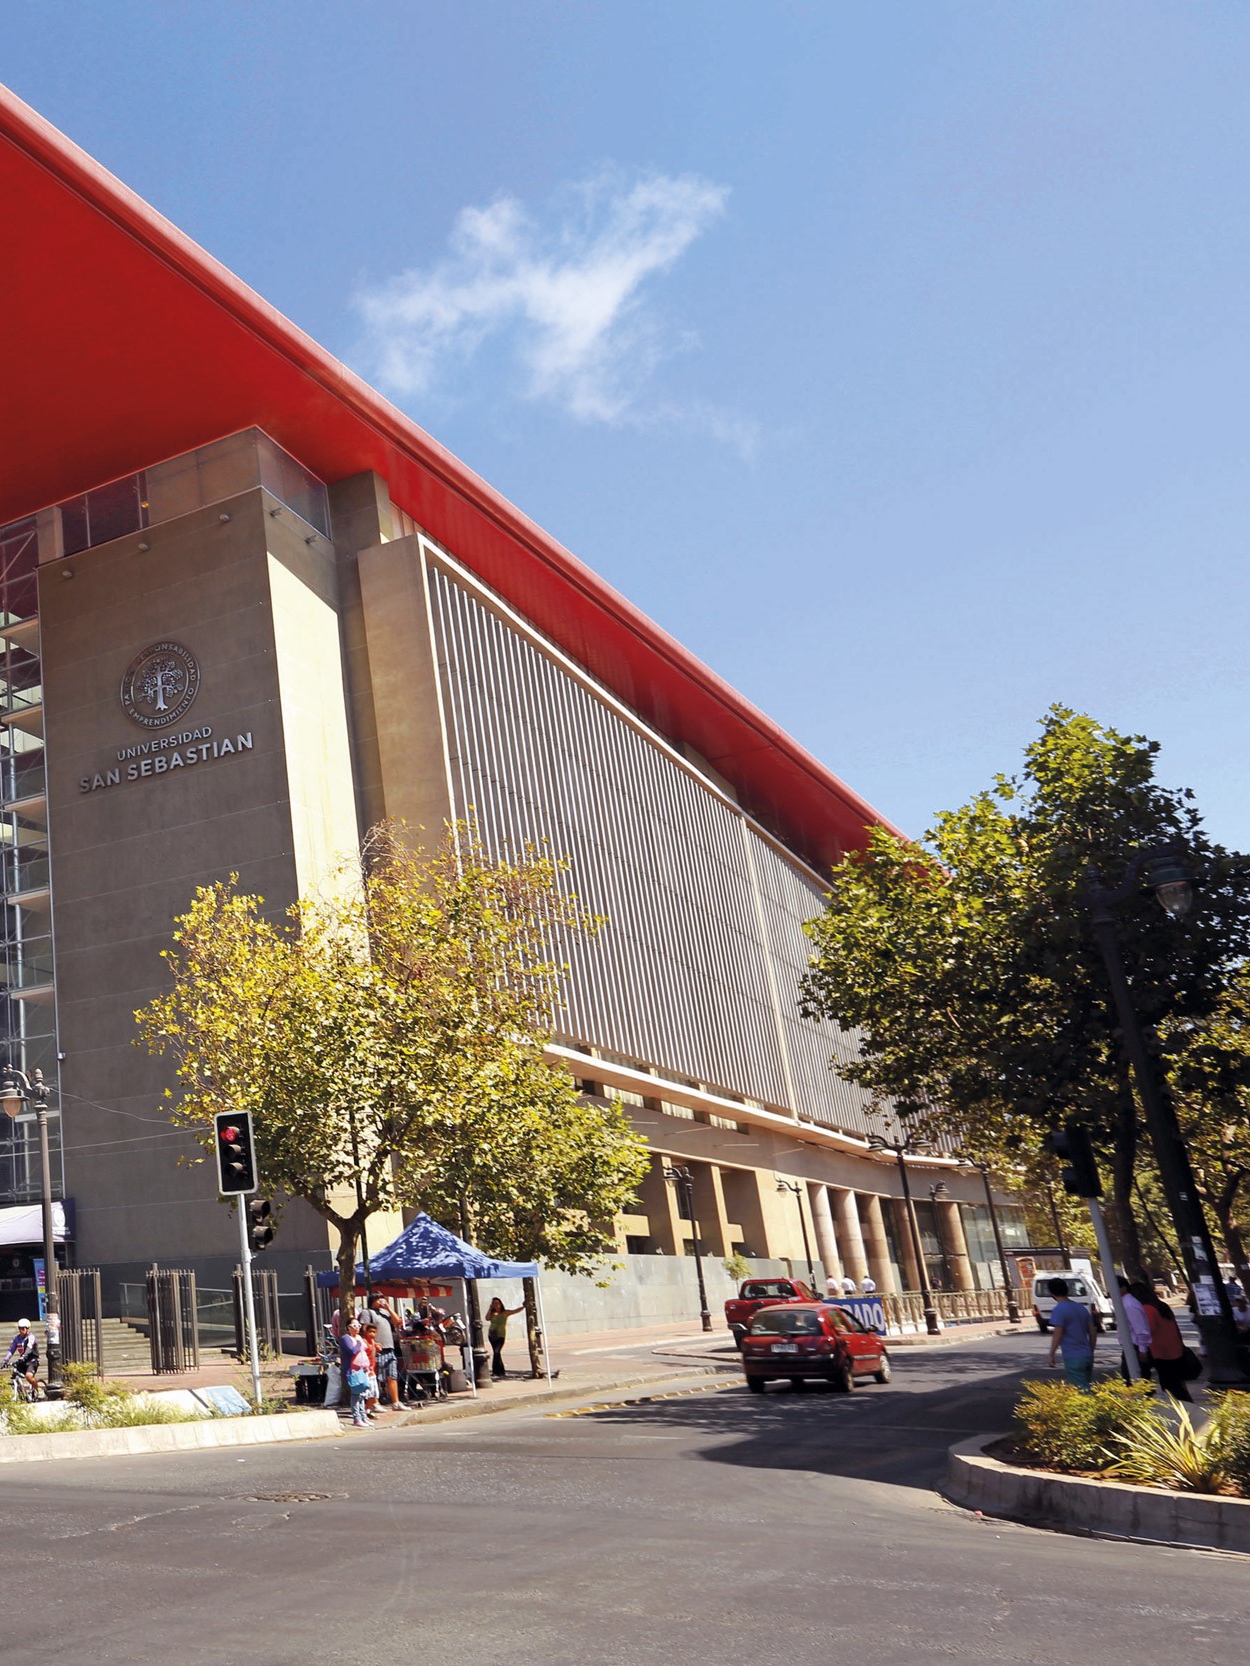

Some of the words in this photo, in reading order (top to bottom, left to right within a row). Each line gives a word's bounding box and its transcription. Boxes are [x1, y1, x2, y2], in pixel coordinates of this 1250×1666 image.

[129, 687, 194, 726] EMPRENDIMIENTO
[80, 767, 121, 793] SAN
[127, 732, 254, 781] SEBASTIAN
[117, 726, 212, 761] UNIVERSIDAD
